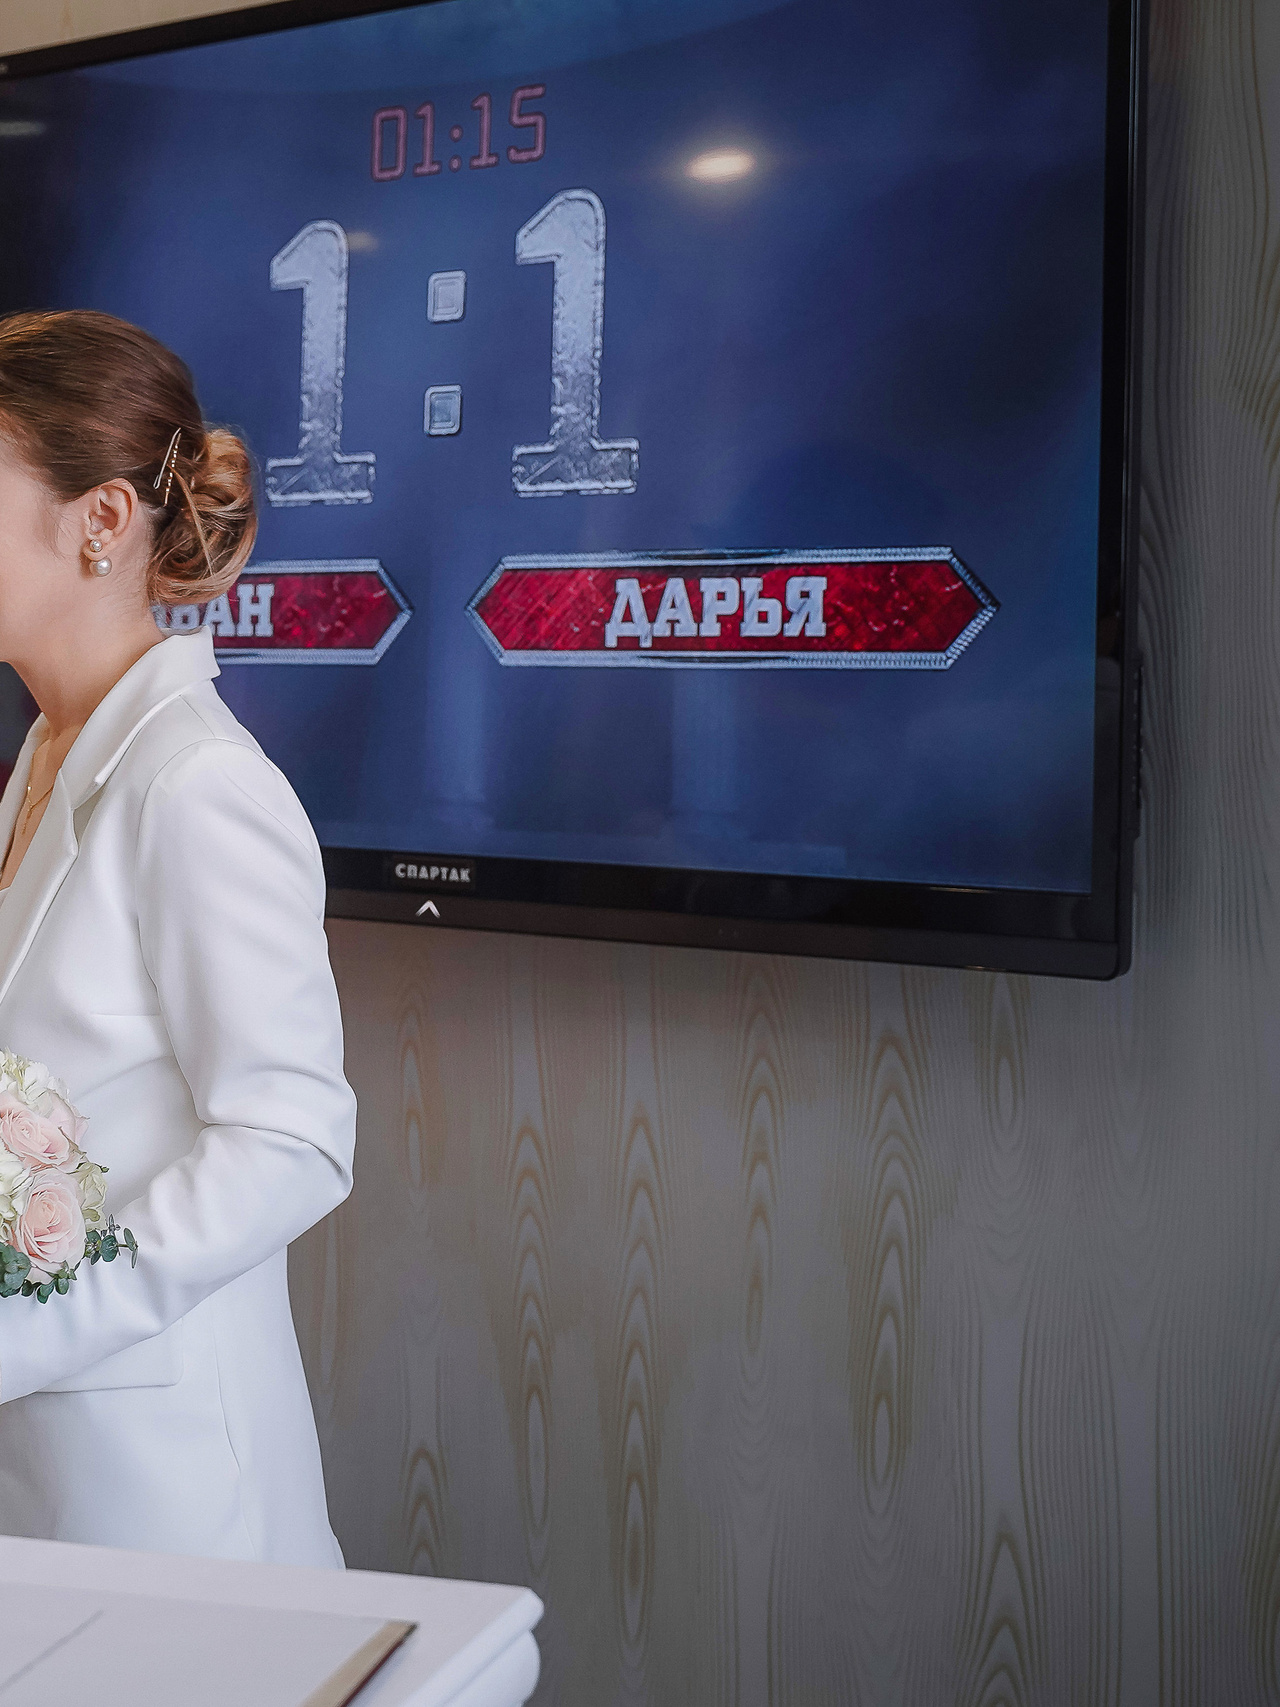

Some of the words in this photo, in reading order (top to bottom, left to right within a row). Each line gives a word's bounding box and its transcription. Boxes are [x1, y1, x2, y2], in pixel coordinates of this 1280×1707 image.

[372, 84, 546, 182] 01:15
[150, 583, 275, 637] ВАН
[604, 575, 828, 649] ДАРЬЯ
[395, 863, 471, 882] СПАРТАК
